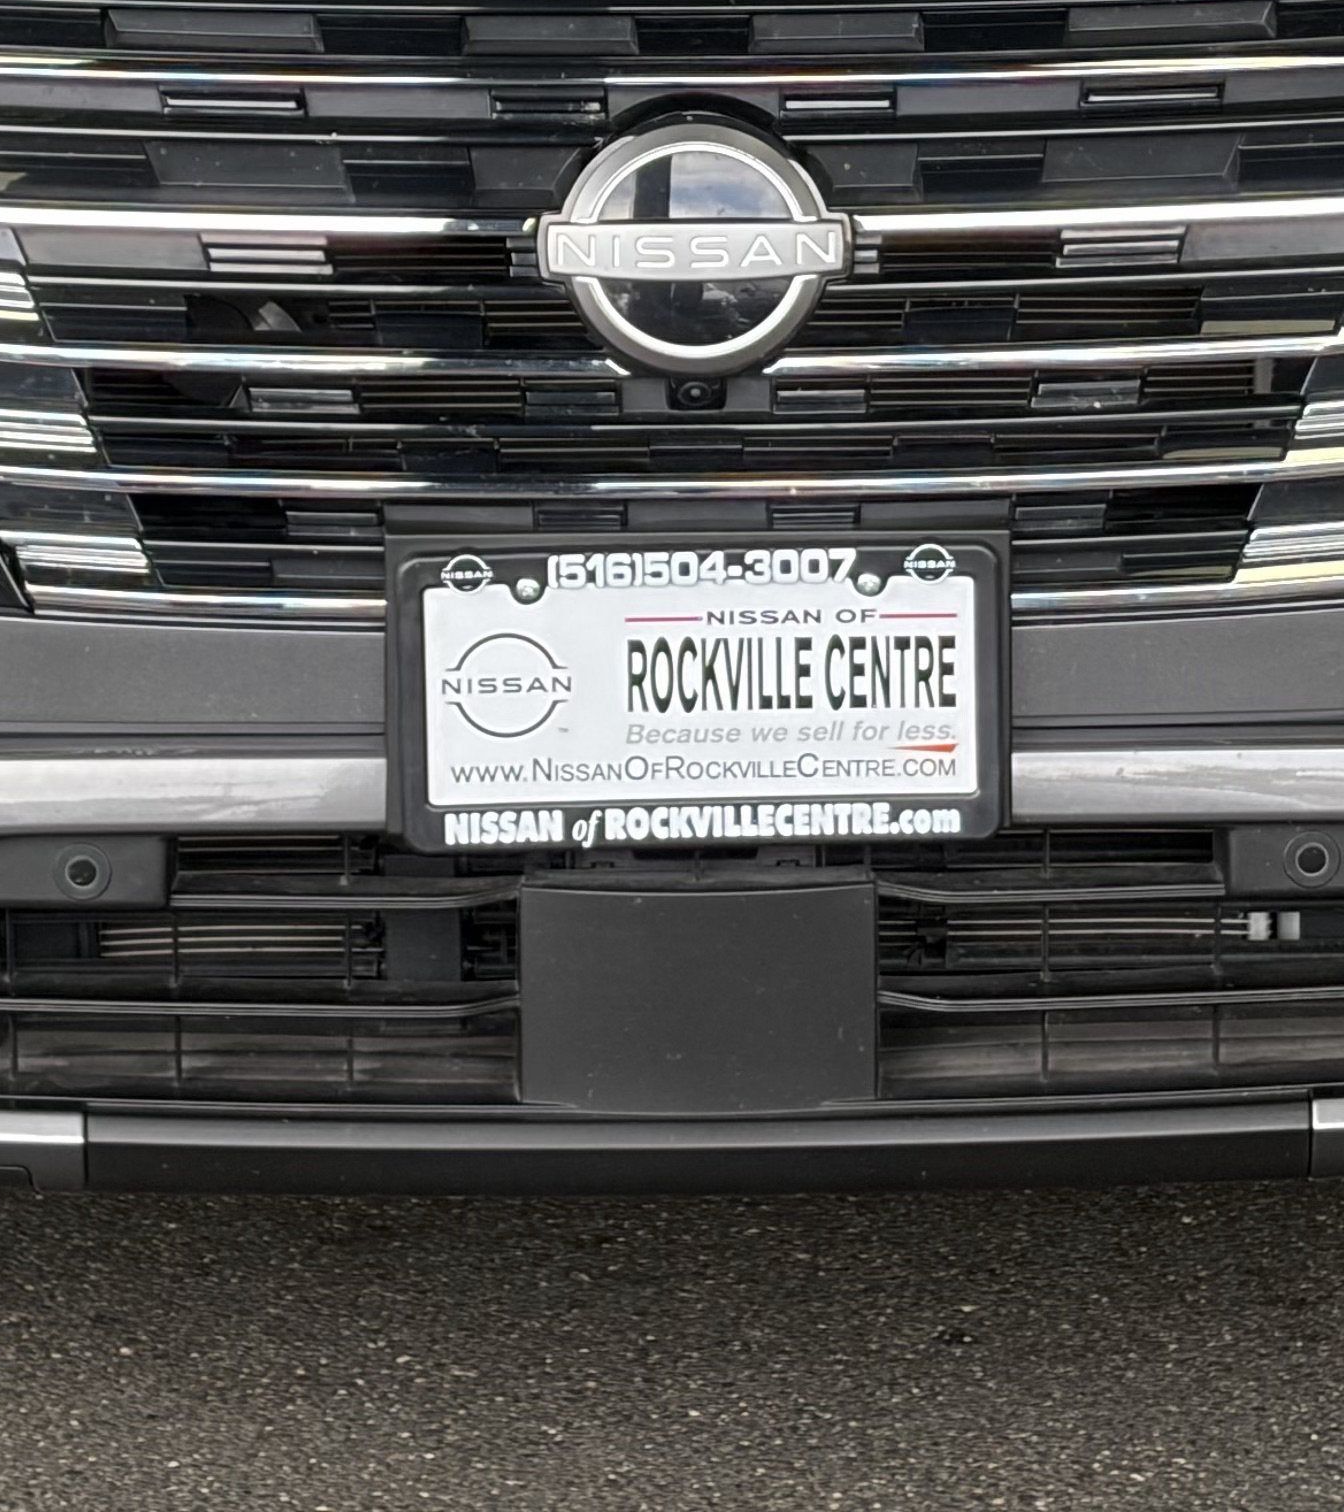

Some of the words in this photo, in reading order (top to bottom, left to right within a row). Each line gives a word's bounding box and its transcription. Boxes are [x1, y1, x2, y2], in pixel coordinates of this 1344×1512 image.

[556, 231, 837, 269] NISSAN
[440, 570, 494, 580] NISSAN
[547, 548, 858, 589] (516)504-3007
[903, 559, 957, 569] NISSAN
[706, 609, 823, 626] NISSAN
[835, 608, 878, 624] OF
[441, 676, 572, 695] NISSAN
[626, 635, 814, 714] ROCKVILLE
[824, 633, 957, 711] CENTRE
[625, 724, 741, 745] Because
[751, 729, 788, 742] we
[796, 720, 845, 742] sell
[851, 720, 891, 740] for
[896, 719, 956, 740] less.
[444, 809, 565, 846] NISSAN
[571, 809, 603, 849] of
[605, 801, 962, 842] ROCKVILLECENTRE.com
